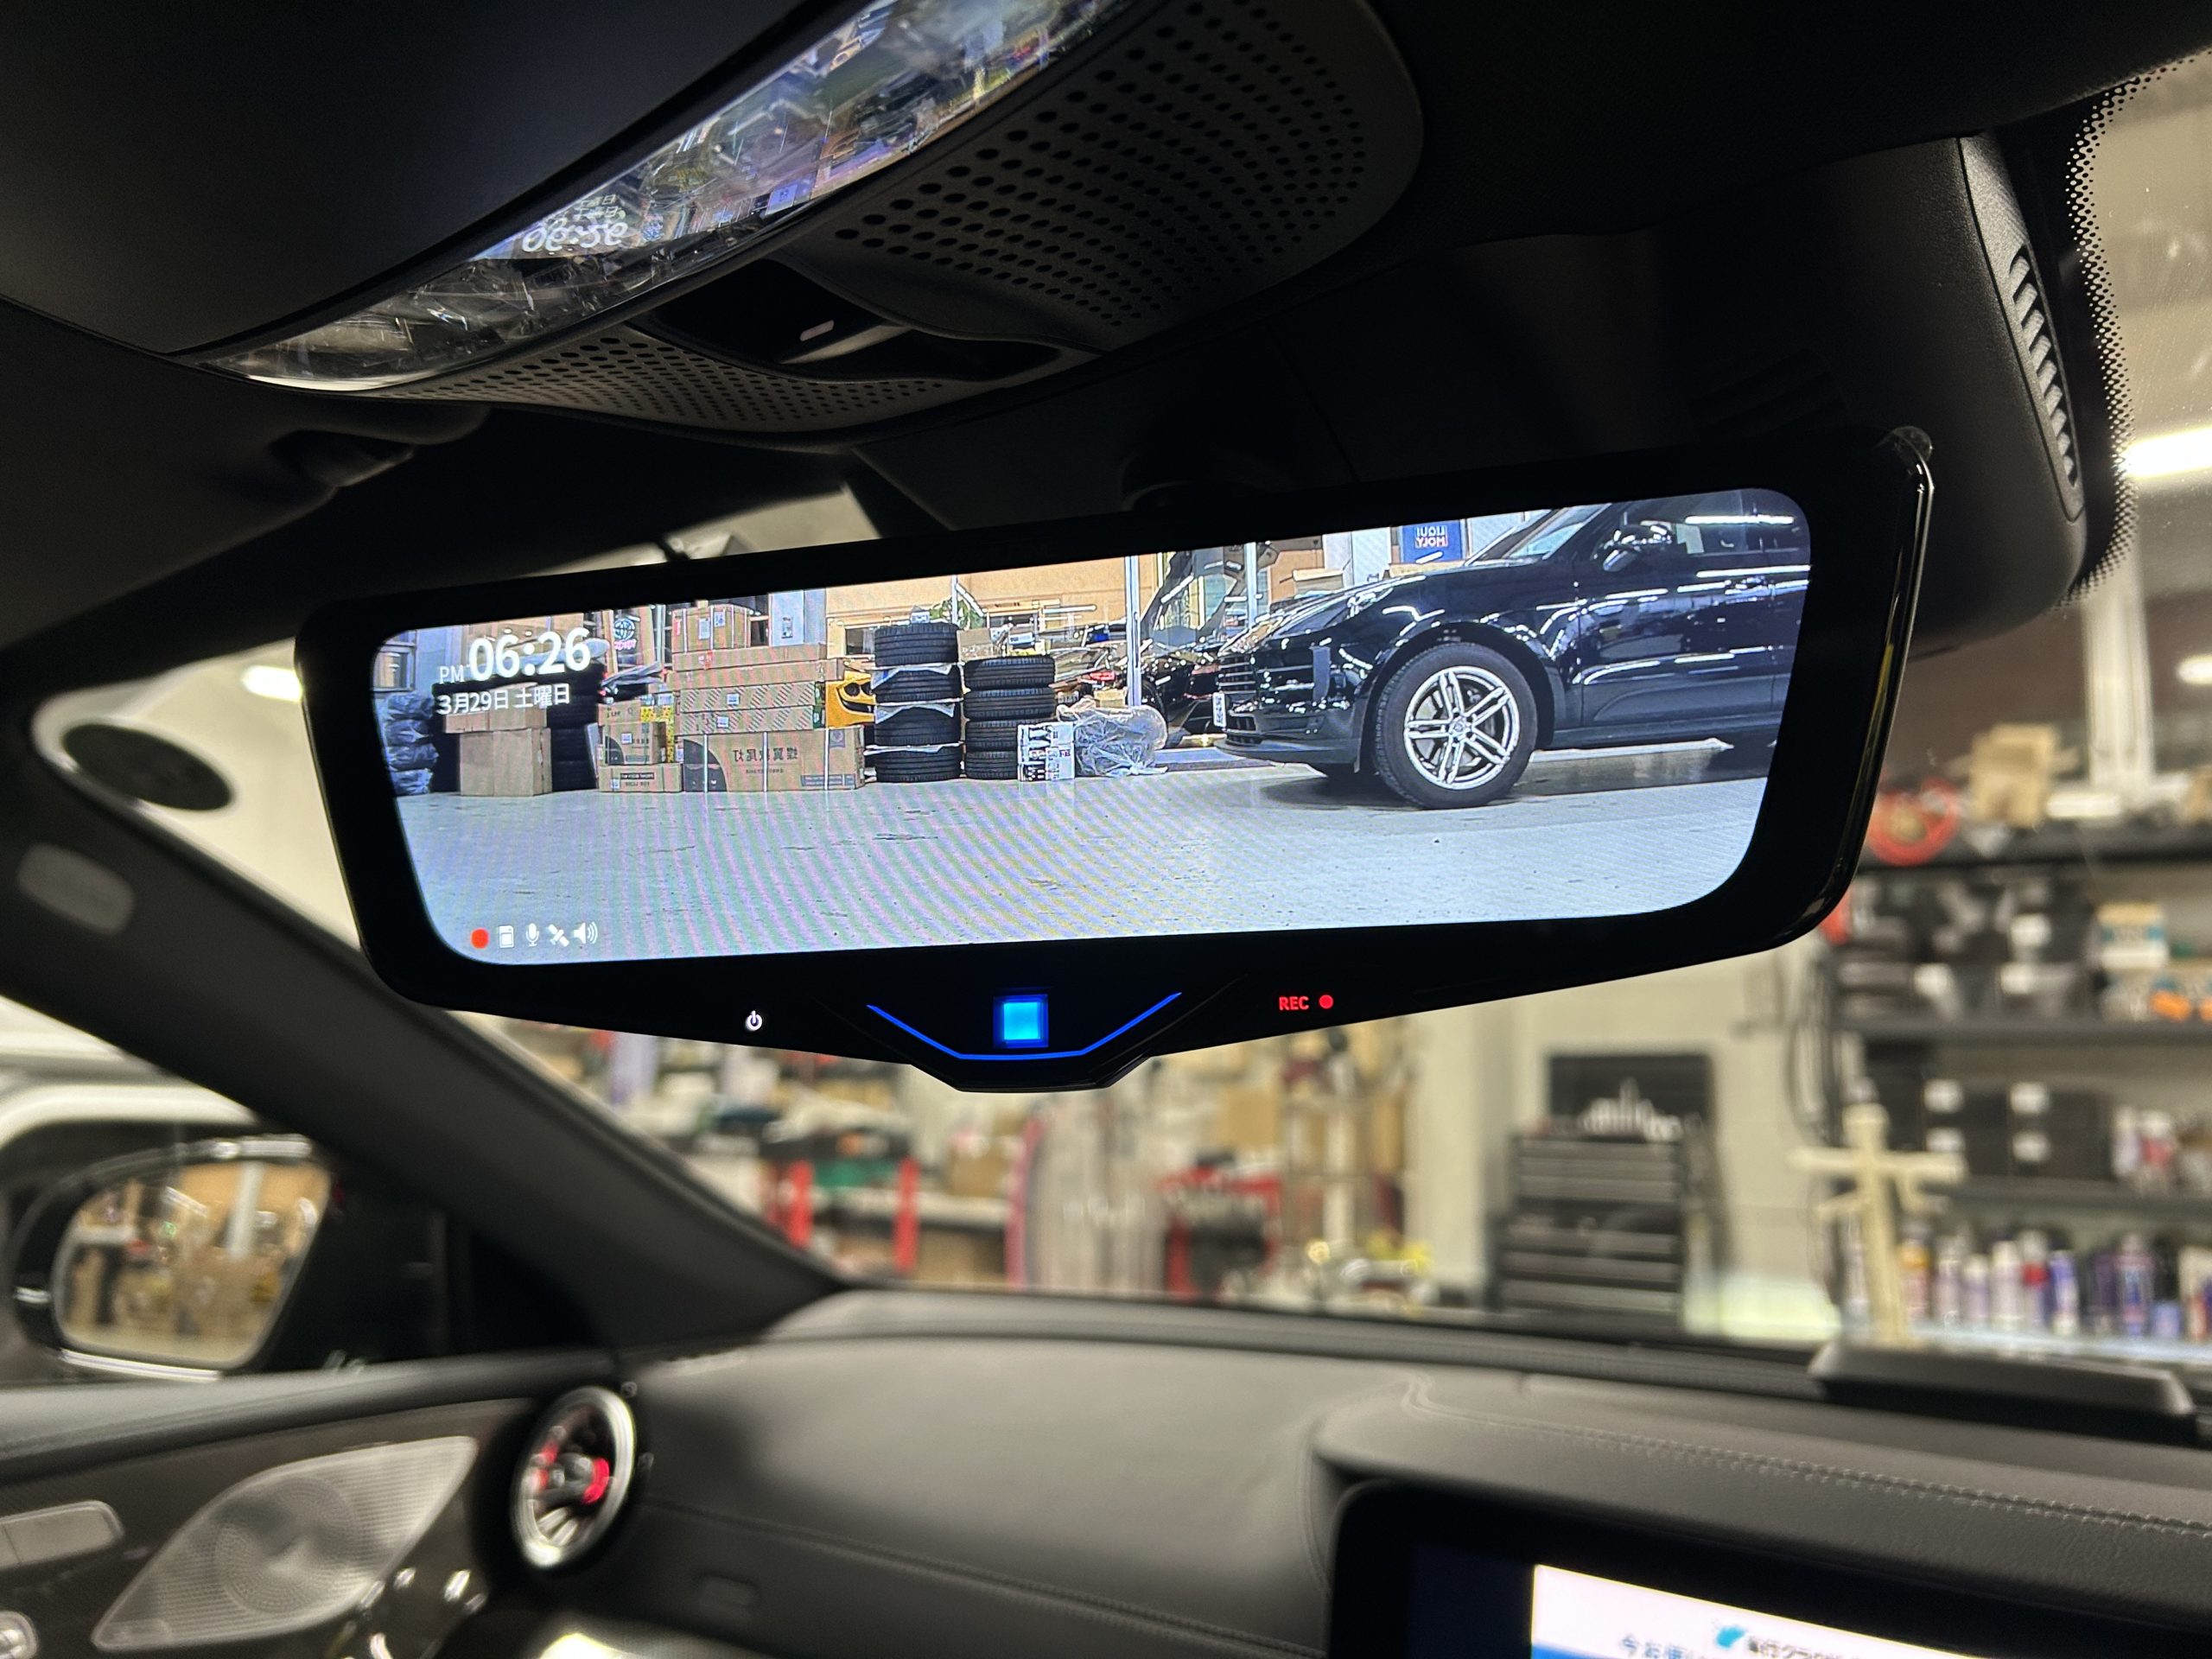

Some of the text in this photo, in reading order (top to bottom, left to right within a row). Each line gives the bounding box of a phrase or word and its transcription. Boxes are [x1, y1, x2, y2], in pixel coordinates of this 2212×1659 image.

[438, 627, 591, 683] PM 06:26
[436, 683, 570, 715] 3月29日 土曜日
[1279, 996, 1309, 1011] REC
